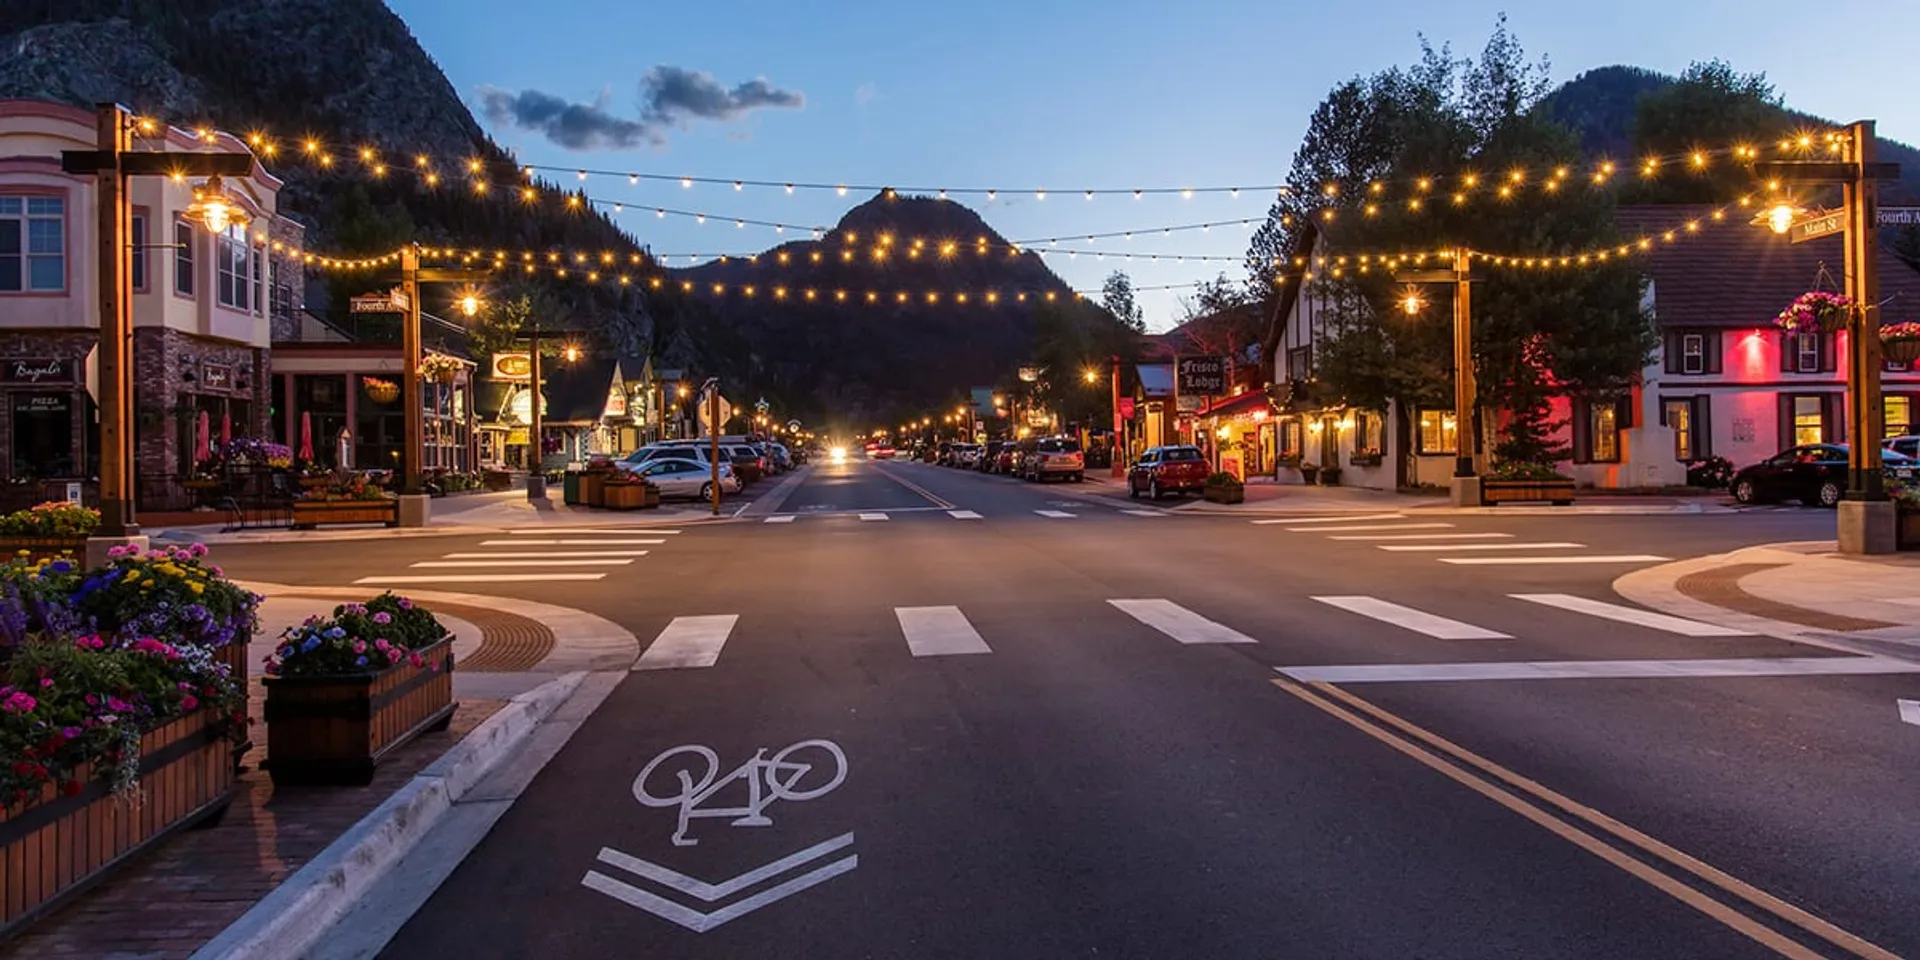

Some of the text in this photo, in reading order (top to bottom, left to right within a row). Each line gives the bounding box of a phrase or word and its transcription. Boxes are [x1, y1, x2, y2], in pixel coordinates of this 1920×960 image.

[1876, 211, 1911, 224] Fourth
[1804, 221, 1827, 236] Main
[356, 300, 385, 311] Fourth
[1180, 360, 1219, 375] Frisco
[1184, 375, 1221, 389] Lodge
